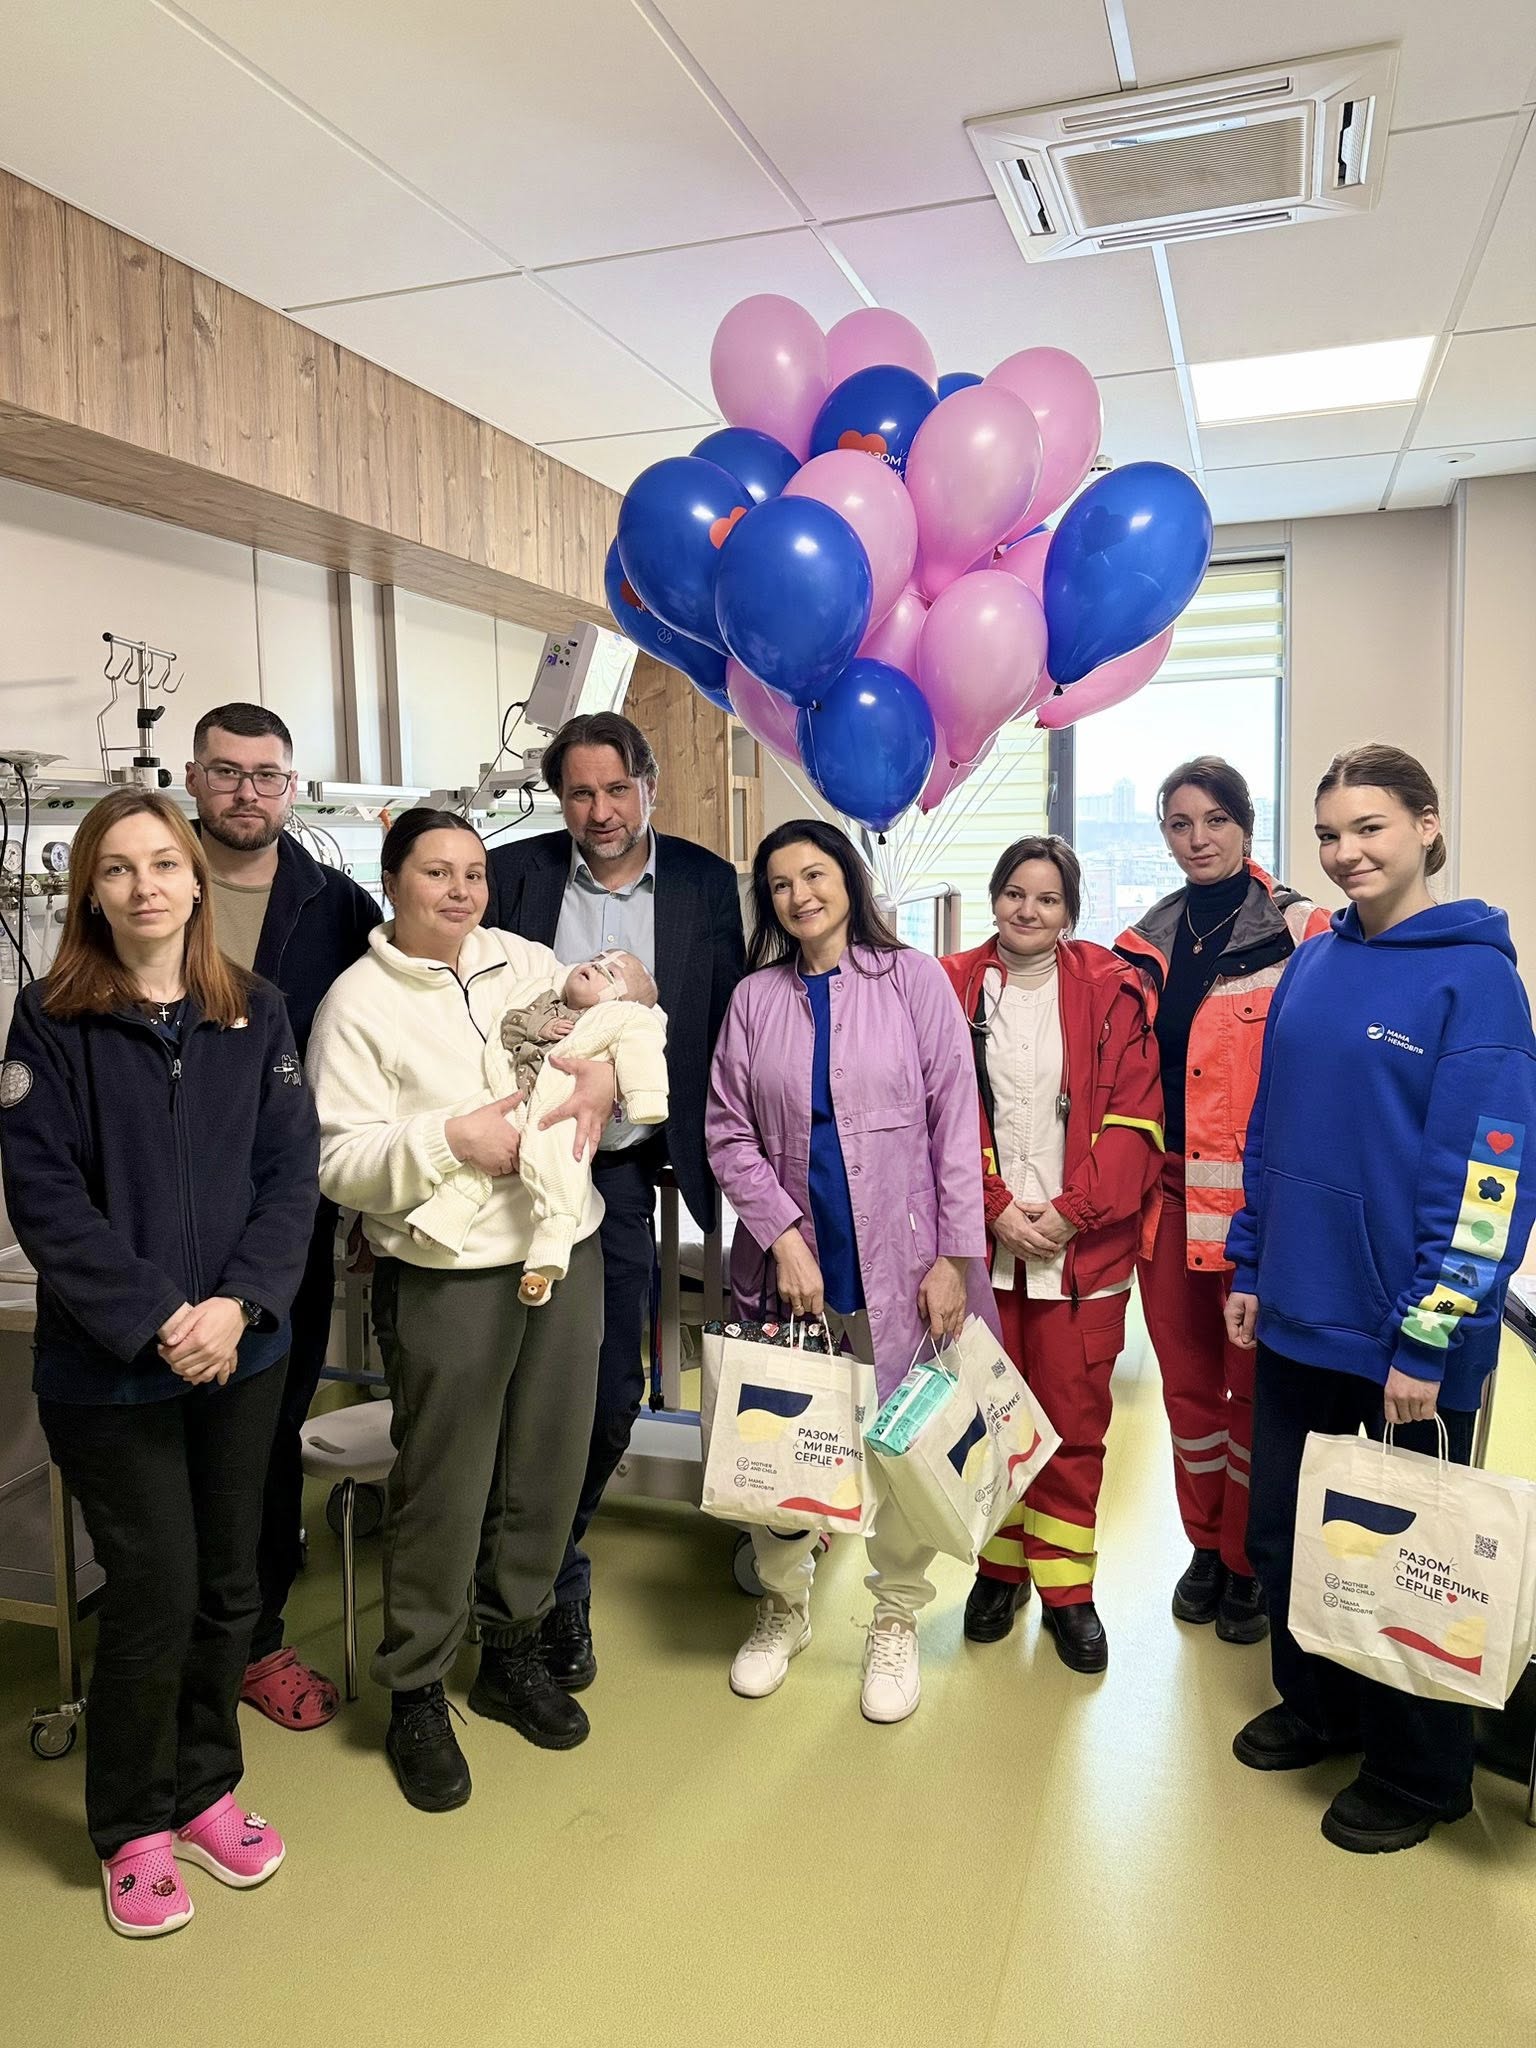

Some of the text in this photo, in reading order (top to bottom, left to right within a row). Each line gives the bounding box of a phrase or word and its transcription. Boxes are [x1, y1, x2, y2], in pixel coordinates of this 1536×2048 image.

[1387, 1029, 1410, 1043] МАМА
[1387, 1037, 1424, 1055] НЕМОВЛЯ
[798, 1428, 838, 1442] РАЗОМ
[794, 1451, 833, 1465] СЕРЦЕ
[803, 1441, 864, 1461] МИ ВЕЛИКЕ
[750, 1461, 773, 1469] MOTHER
[1399, 1548, 1451, 1576] РАЗОМ
[1341, 1579, 1369, 1590] MOTHER
[1341, 1586, 1376, 1597] AND CHILD
[1396, 1575, 1443, 1601] СЕРЦЕ
[1406, 1565, 1489, 1604] МИ ВЕЛИКЕ
[1339, 1598, 1360, 1608] МАМА
[1341, 1605, 1374, 1616] НЕМОВЛЯ
